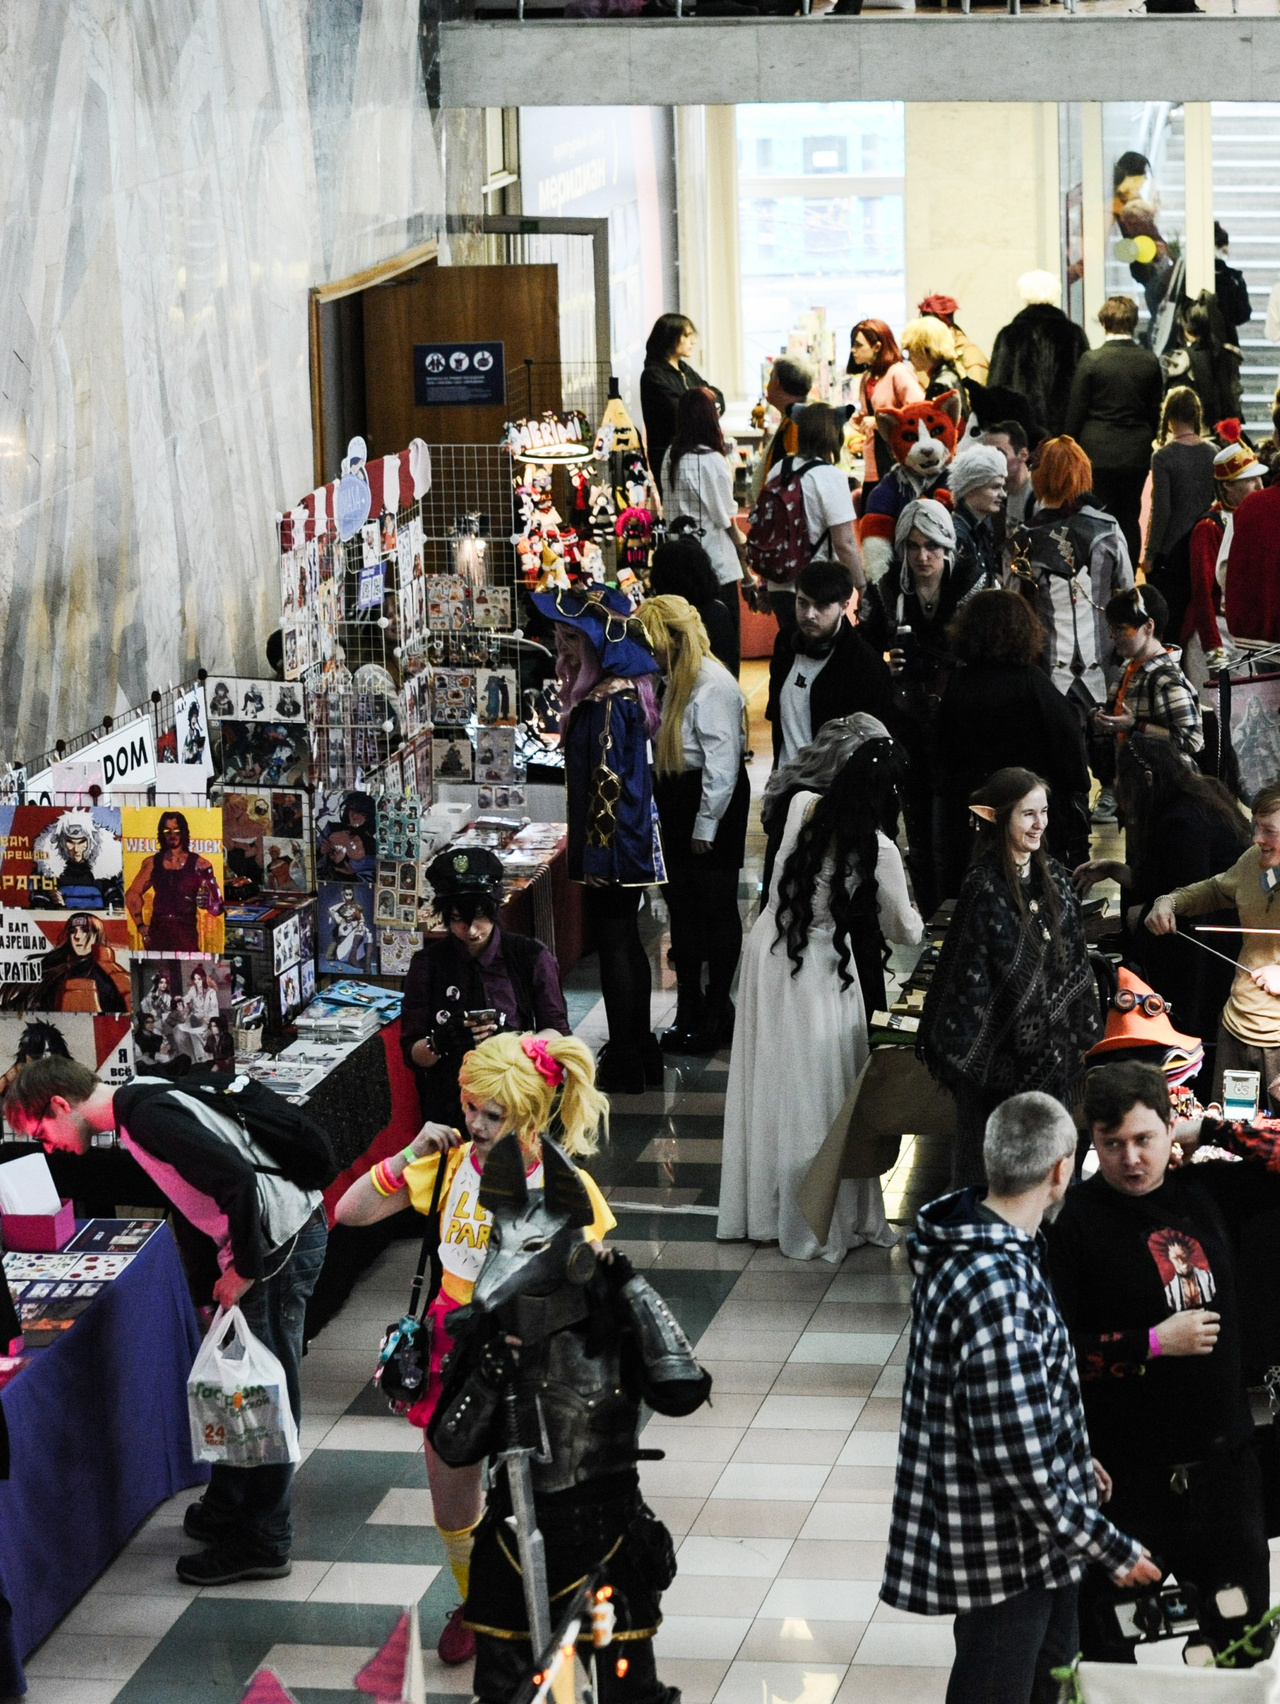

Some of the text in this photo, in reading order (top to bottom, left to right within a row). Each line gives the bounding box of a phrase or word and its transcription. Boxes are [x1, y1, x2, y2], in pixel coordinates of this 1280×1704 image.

[100, 737, 148, 785] DOM
[0, 836, 29, 847] ВАМ
[126, 838, 221, 853] WELL FUCK
[0, 851, 50, 860] ПРЕЩАЮ
[0, 875, 58, 890] РАТЬ!
[0, 935, 47, 950] АЗРЕШАЮ
[0, 962, 42, 981] РАТЬ!
[118, 1048, 128, 1063] Я
[453, 1191, 487, 1221] LE
[445, 1219, 491, 1250] PAR
[205, 1424, 225, 1439] 24
